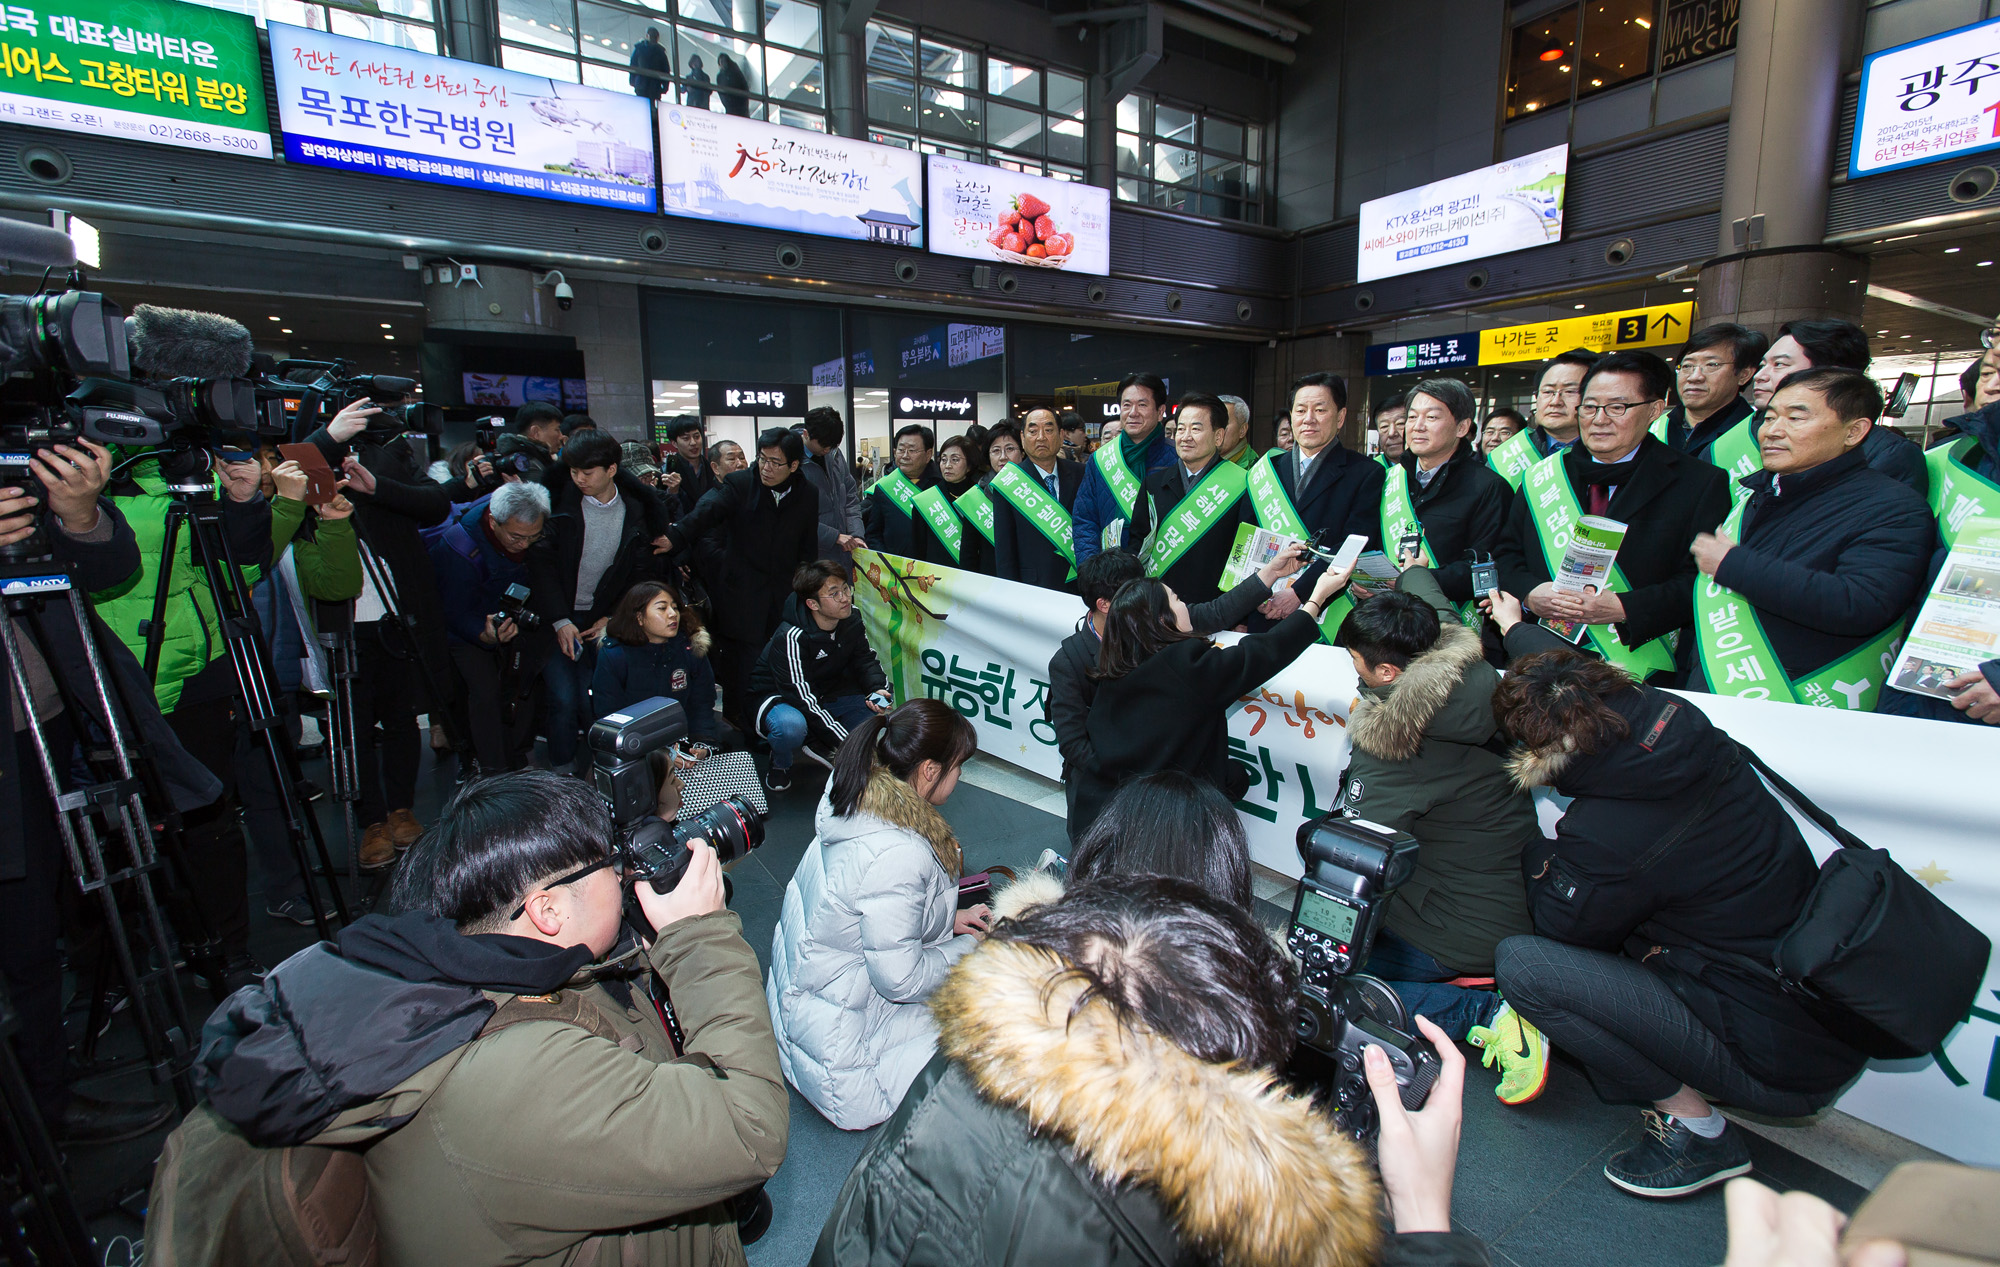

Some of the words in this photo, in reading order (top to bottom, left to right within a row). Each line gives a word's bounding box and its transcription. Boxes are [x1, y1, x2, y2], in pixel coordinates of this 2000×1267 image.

[1664, 3, 1716, 52] MADE
[48, 15, 219, 69] 대표실버타운
[80, 58, 190, 107] 고창타워
[195, 76, 248, 115] 분양
[292, 47, 342, 76] 전남
[349, 60, 418, 89] 서남권
[424, 74, 468, 97] 의료의
[473, 78, 509, 108] 중심
[1896, 52, 2000, 112] 광주
[0, 103, 16, 116] 대
[22, 105, 65, 121] 그랜드
[70, 112, 104, 128] 오픈!
[149, 124, 258, 151] 02)2668-5300
[298, 86, 516, 155] 목포한국병원
[1877, 116, 1933, 136] 2010-2015년
[1922, 117, 1969, 134] 여자대학교
[1970, 114, 1980, 125] 중
[771, 137, 795, 154] 2017
[1874, 145, 1898, 162] 6년
[1901, 138, 1931, 157] 연속
[1932, 126, 1980, 149] 취업률
[301, 142, 376, 167] 권역외상센터
[383, 155, 476, 181] 권역응급의료센터
[481, 169, 545, 191] 심뇌혈관센터
[551, 180, 646, 205] 노인공공전문진료센터
[728, 142, 803, 181] 찾아라!
[808, 165, 840, 186] 전남
[841, 168, 871, 192] 강진
[956, 178, 992, 194] 논산의
[956, 194, 992, 212] 겨울은
[1448, 194, 1481, 216] 광고!!
[1494, 330, 1537, 348] 나가는
[1545, 326, 1559, 344] 곳
[1583, 333, 1612, 346] 전자상가
[1624, 319, 1640, 340] 3
[1418, 342, 1441, 358] 타는
[1446, 339, 1459, 355] 곳
[1418, 357, 1437, 367] Tracks
[1501, 348, 1517, 357] Way
[1518, 347, 1531, 356] out
[106, 413, 140, 423] FUJINON
[1102, 443, 1118, 471] 새해
[1112, 467, 1125, 486] 복
[1500, 442, 1533, 477] 새해
[893, 479, 914, 503] 새해
[1000, 471, 1019, 486] 복
[1013, 482, 1044, 508] 많이
[1196, 484, 1229, 518] 새해
[1258, 483, 1273, 501] 복
[1539, 483, 1561, 509] 복
[928, 500, 951, 527] 새해
[944, 525, 959, 540] 복
[1263, 498, 1291, 533] 많이
[1386, 496, 1403, 518] 복
[1180, 510, 1201, 533] 복
[1545, 505, 1575, 549] 많이
[1155, 525, 1185, 562] 많이
[30, 578, 67, 587] NATV
[920, 648, 1017, 731] 유능한
[1804, 682, 1839, 709] 국민
